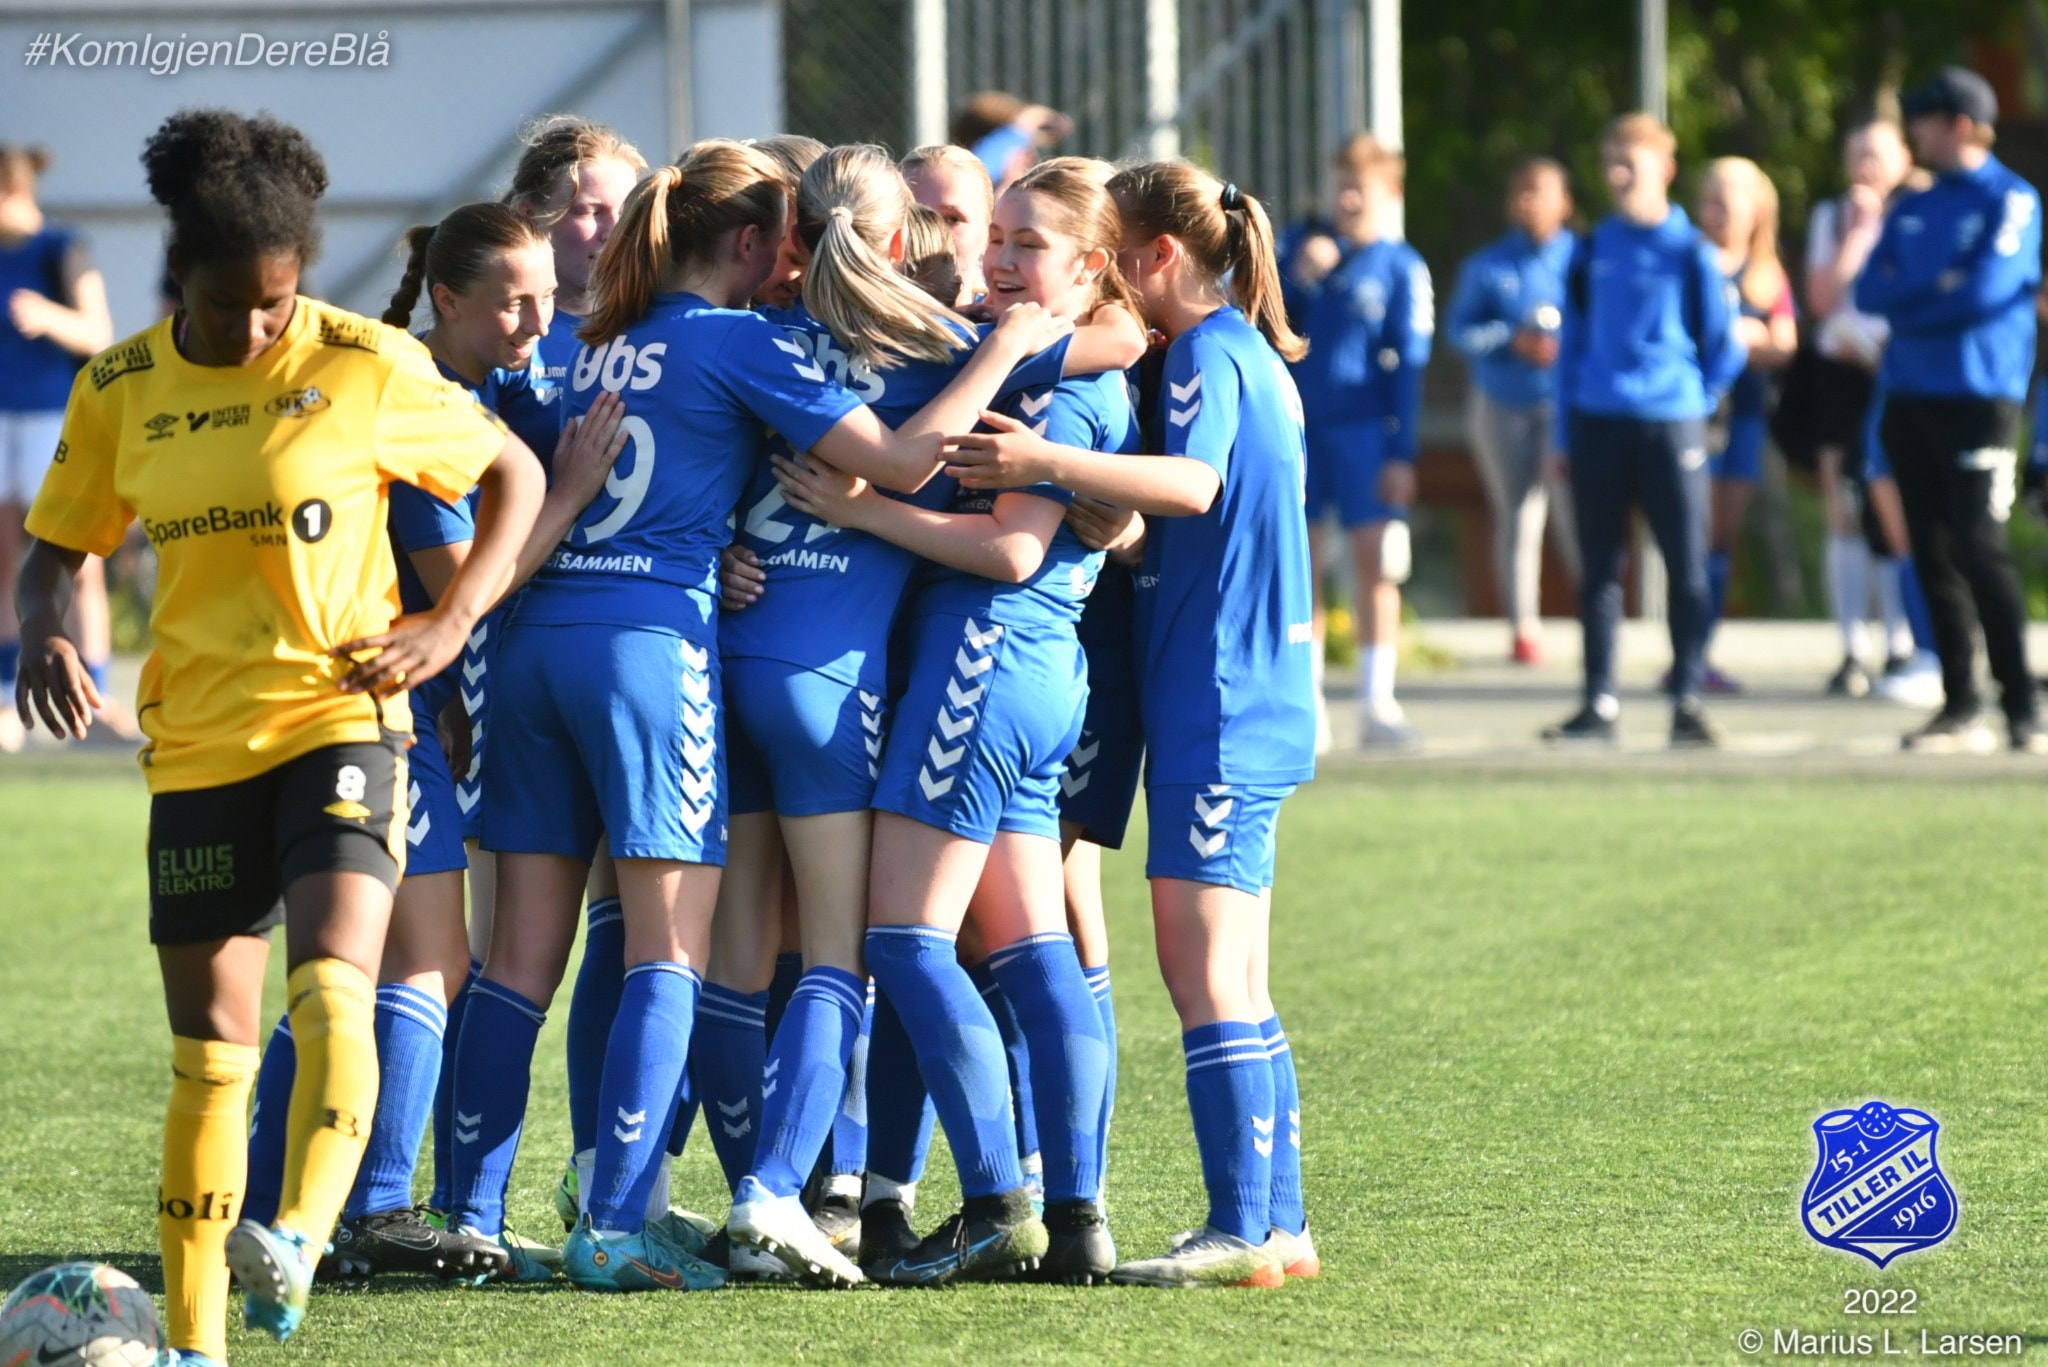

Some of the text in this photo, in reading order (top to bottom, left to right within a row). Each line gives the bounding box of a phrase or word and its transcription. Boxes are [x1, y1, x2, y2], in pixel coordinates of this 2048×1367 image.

[212, 405, 250, 419] INTER
[212, 414, 250, 429] SPORT
[145, 502, 284, 546] SpareBank
[336, 765, 366, 802] 8
[158, 872, 235, 896] ELEKTRO
